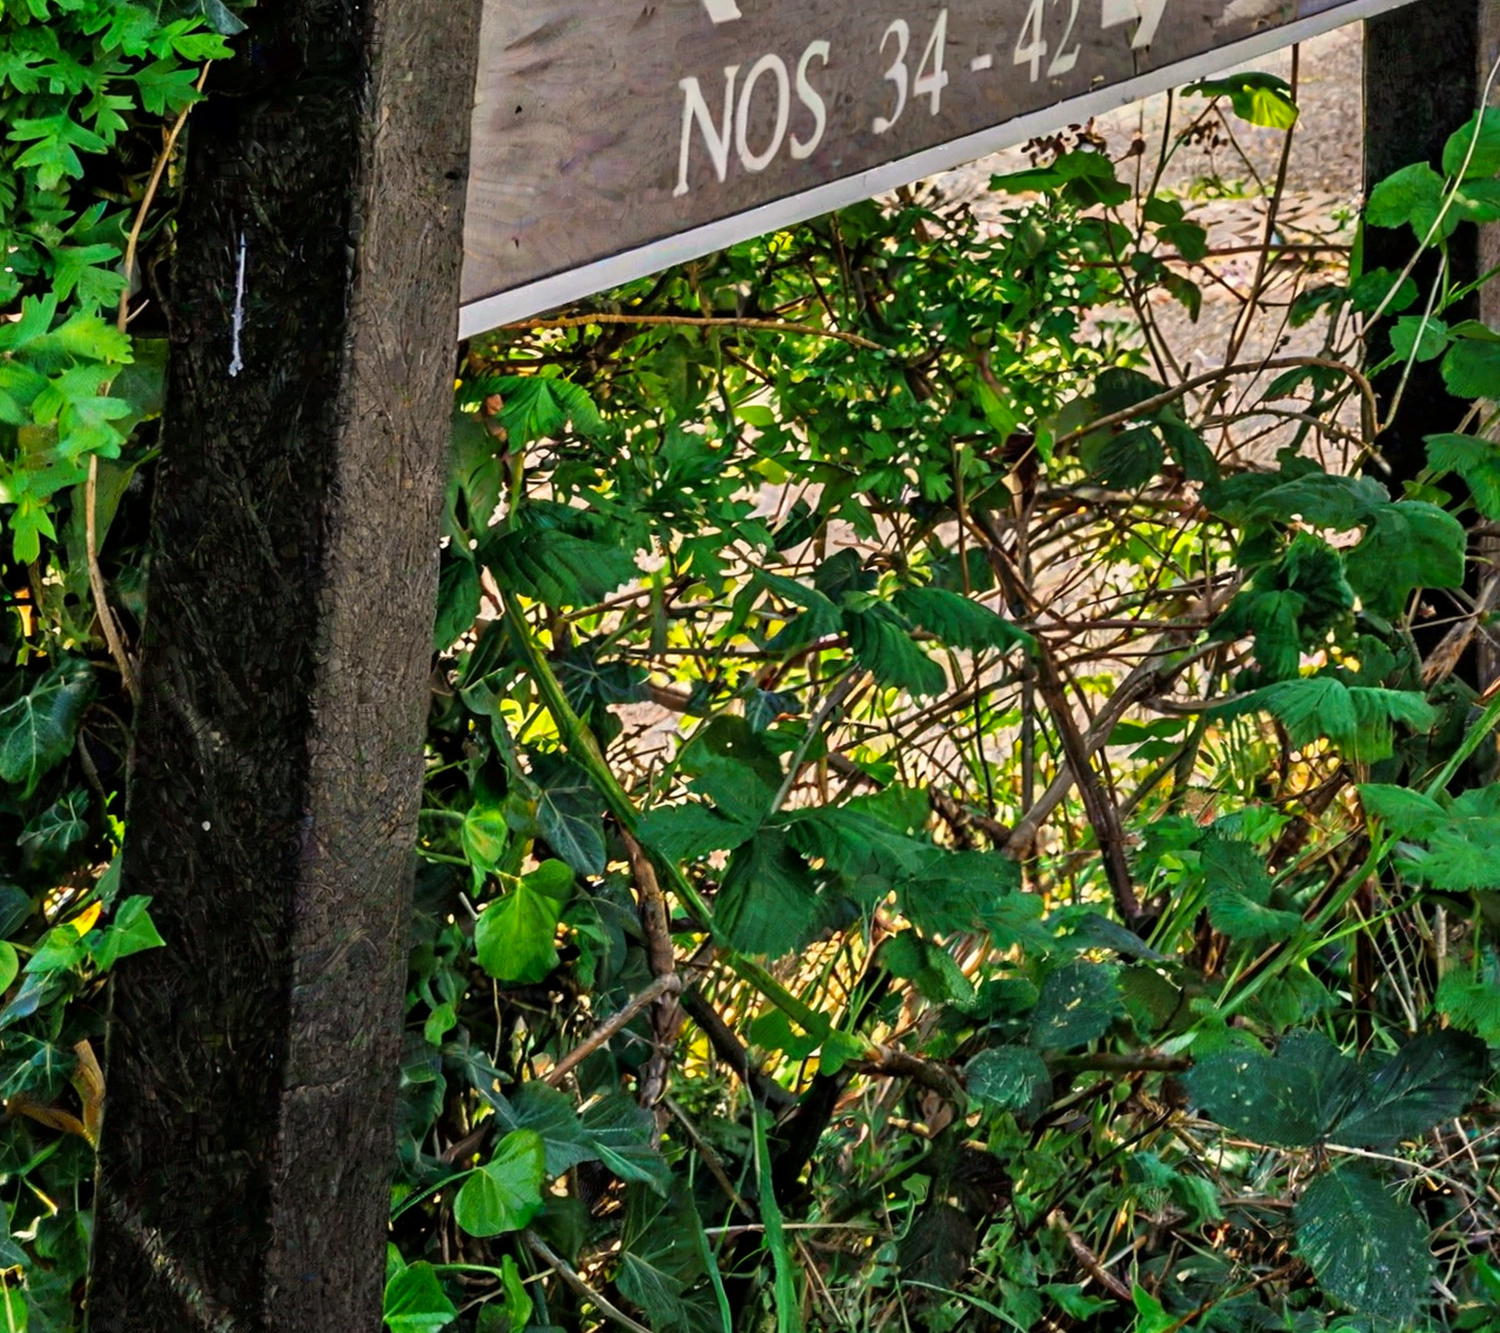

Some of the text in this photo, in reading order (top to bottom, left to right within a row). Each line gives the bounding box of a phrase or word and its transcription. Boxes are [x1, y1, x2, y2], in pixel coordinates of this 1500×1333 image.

[672, 40, 830, 197] NOS
[872, 8, 949, 134] 34
[970, 52, 993, 72] -
